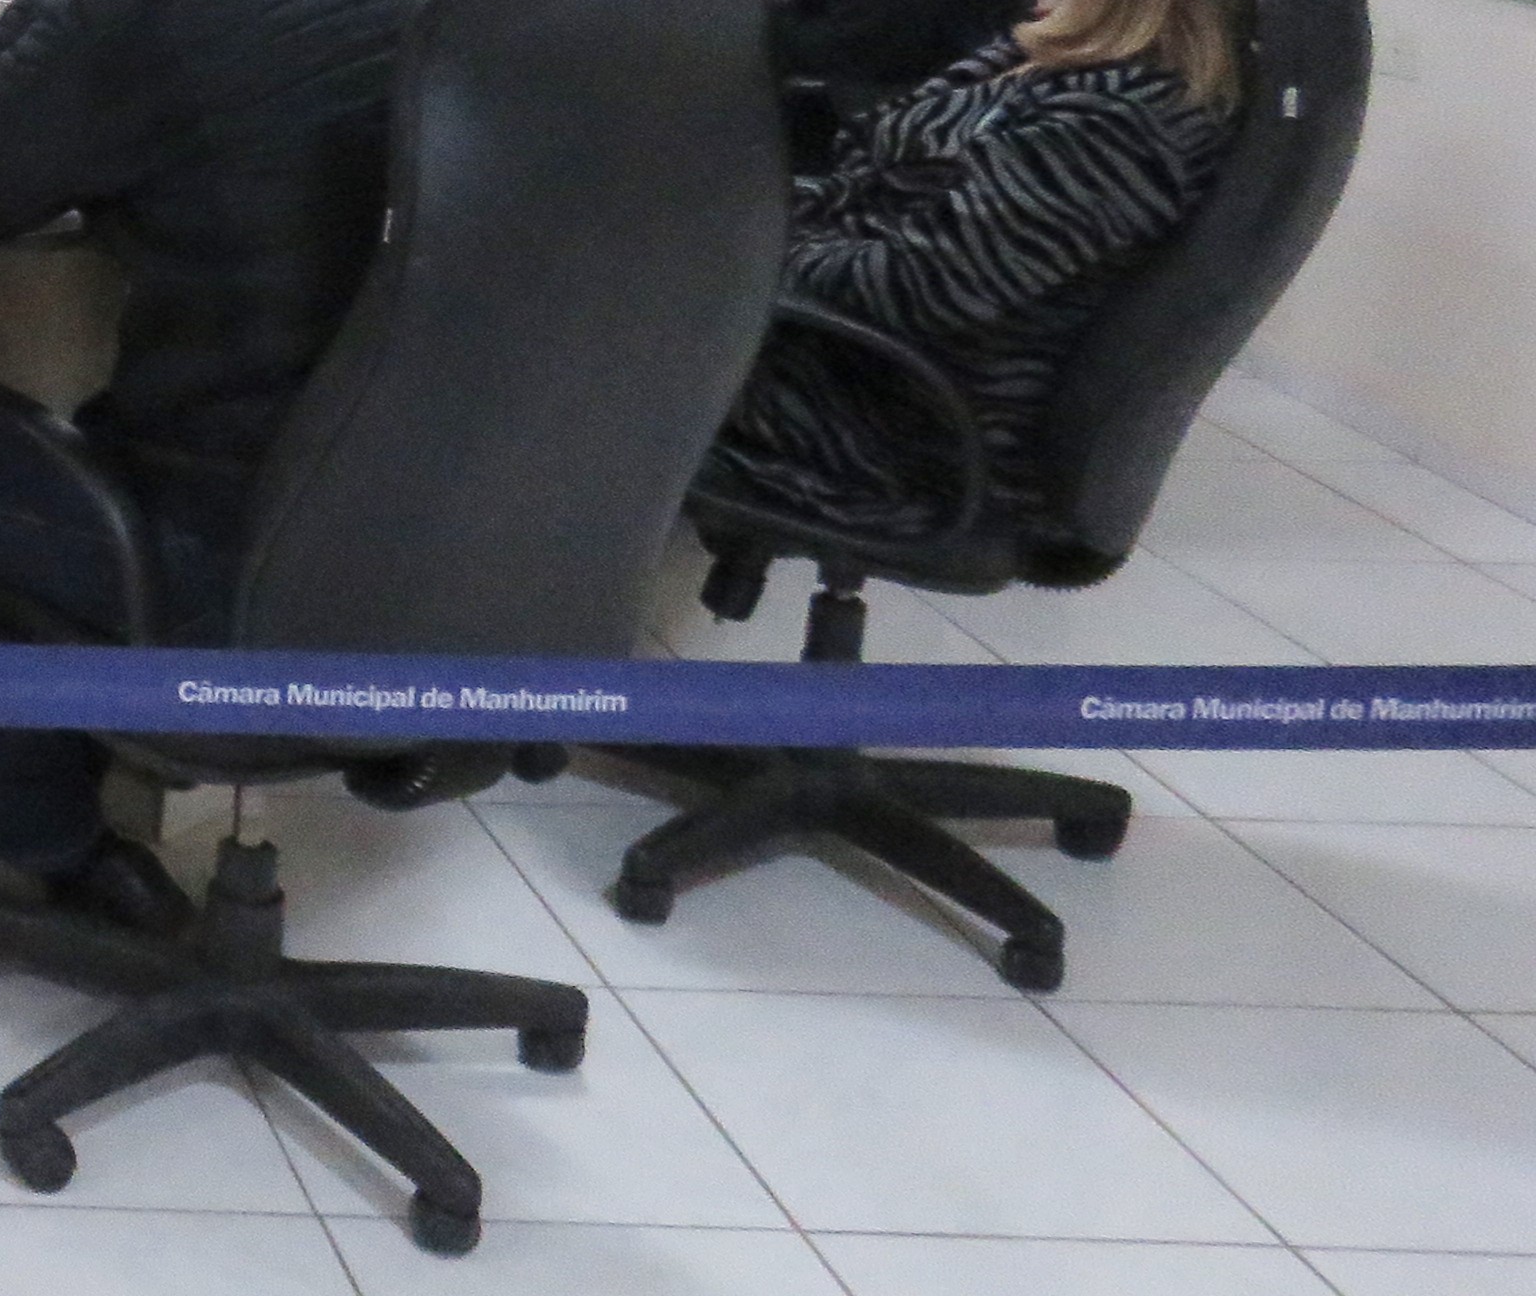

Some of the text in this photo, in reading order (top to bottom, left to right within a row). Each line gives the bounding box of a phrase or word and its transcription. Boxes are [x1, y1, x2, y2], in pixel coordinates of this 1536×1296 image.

[178, 680, 628, 712] Câmara Municipal de Manhumirim
[1081, 695, 1187, 720] Câmara
[1192, 696, 1325, 724] Municipal
[1330, 699, 1364, 720] de
